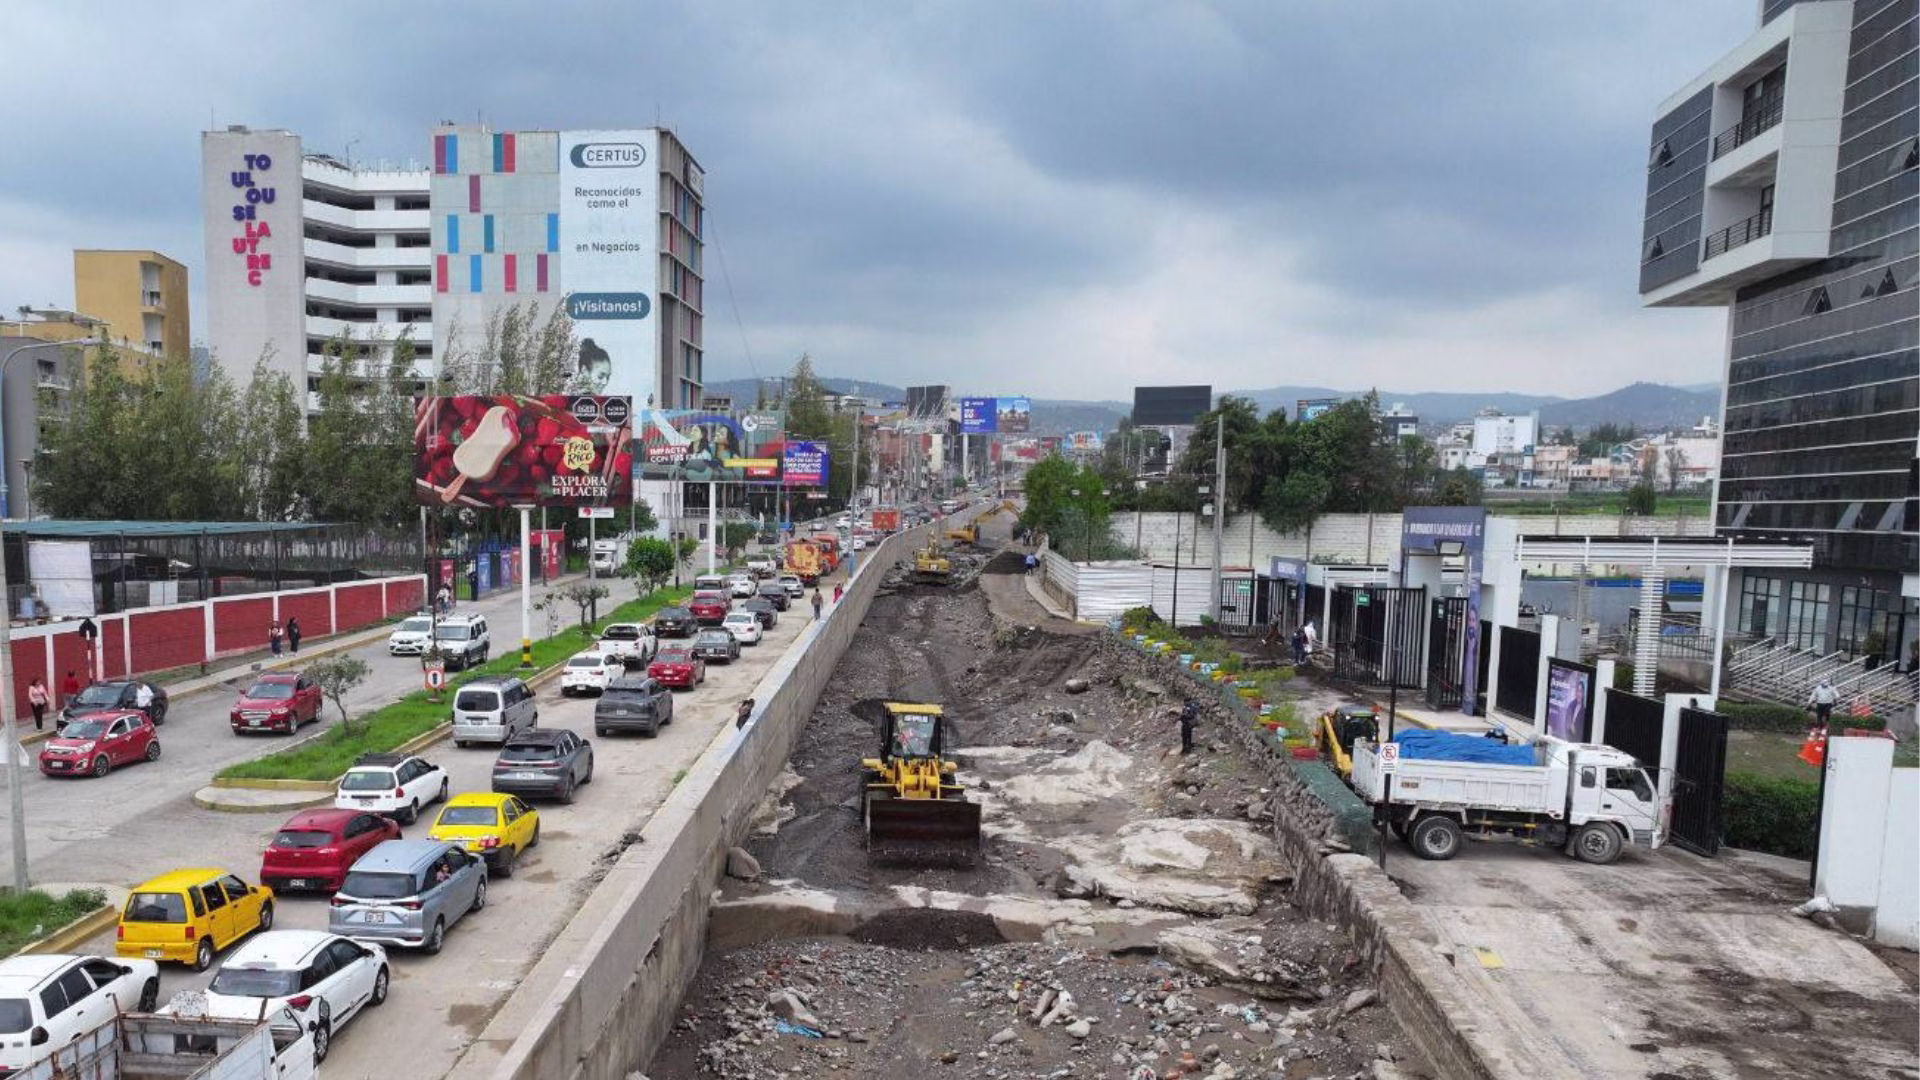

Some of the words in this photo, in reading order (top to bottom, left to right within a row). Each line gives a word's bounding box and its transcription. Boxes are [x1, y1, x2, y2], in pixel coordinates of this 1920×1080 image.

[244, 154, 271, 170] TO
[586, 150, 640, 162] CERTUS
[231, 172, 255, 188] UL
[246, 188, 275, 204] OU
[575, 186, 641, 197] Reconocidos
[587, 200, 616, 208] como
[619, 198, 628, 208] el
[232, 205, 256, 221] SE
[245, 222, 271, 238] LA
[232, 238, 258, 254] UT
[576, 243, 588, 252] en
[592, 241, 640, 254] Negocios
[248, 270, 261, 286] C
[650, 455, 669, 463] CON
[552, 476, 607, 486] EXPLORA
[562, 487, 608, 496] PLACER
